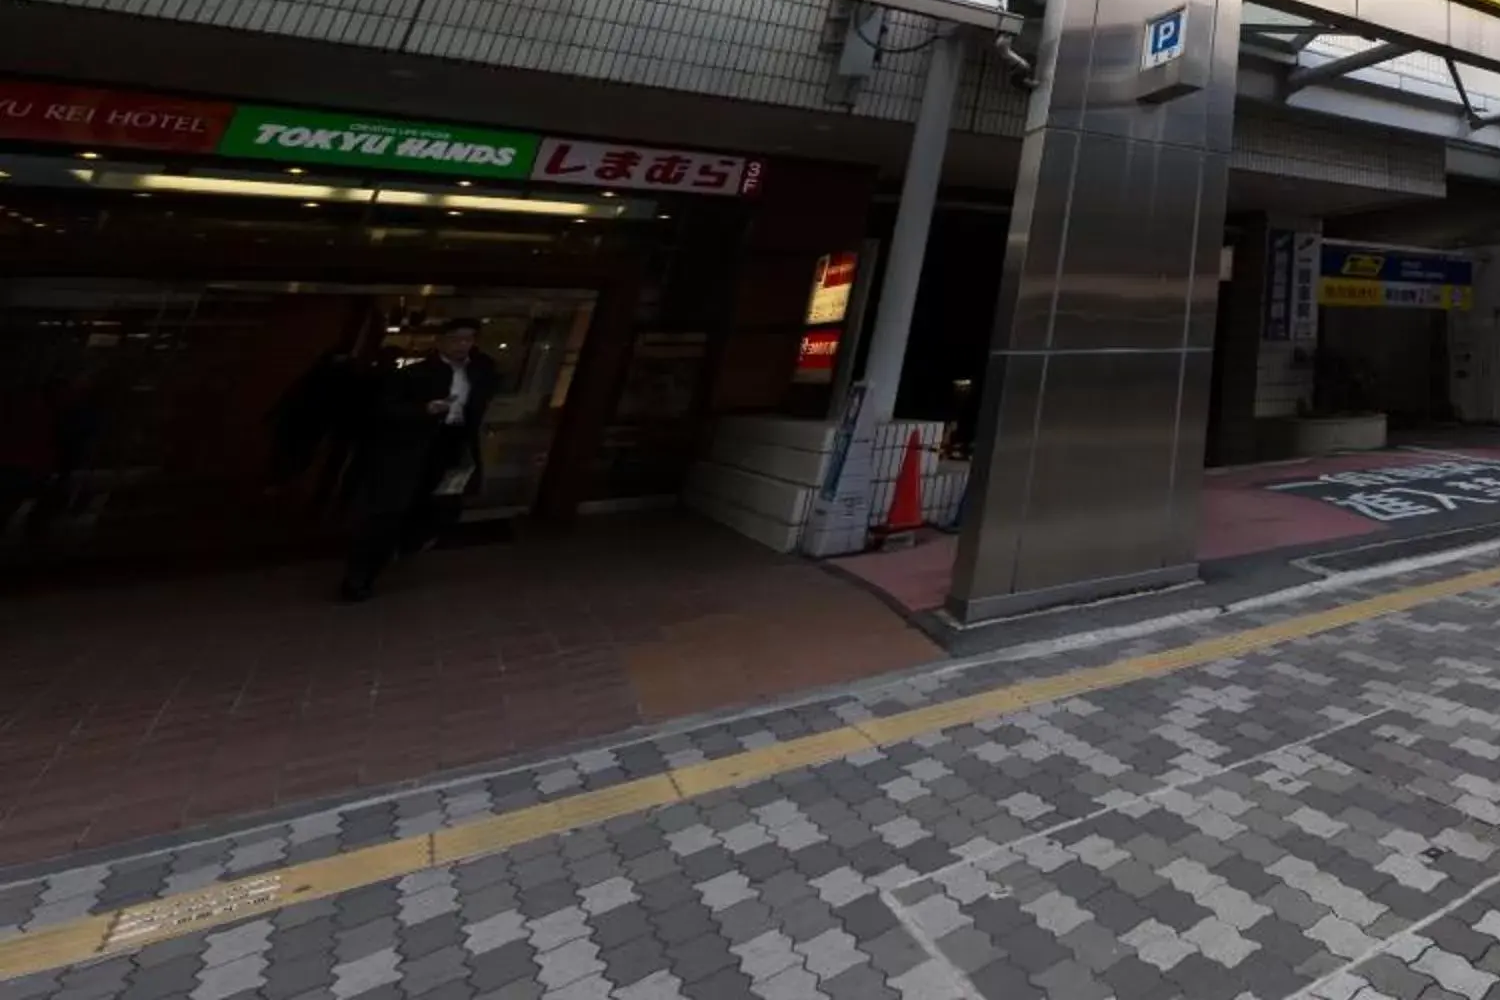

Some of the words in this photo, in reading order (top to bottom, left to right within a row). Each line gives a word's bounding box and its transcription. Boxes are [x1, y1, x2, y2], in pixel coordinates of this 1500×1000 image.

[1157, 21, 1175, 49] P
[43, 103, 96, 123] REI
[107, 109, 207, 135] HOTEL
[254, 123, 395, 155] TOKYU
[395, 138, 518, 167] HANDS
[545, 143, 736, 188] しまむら
[742, 161, 762, 194] 3F
